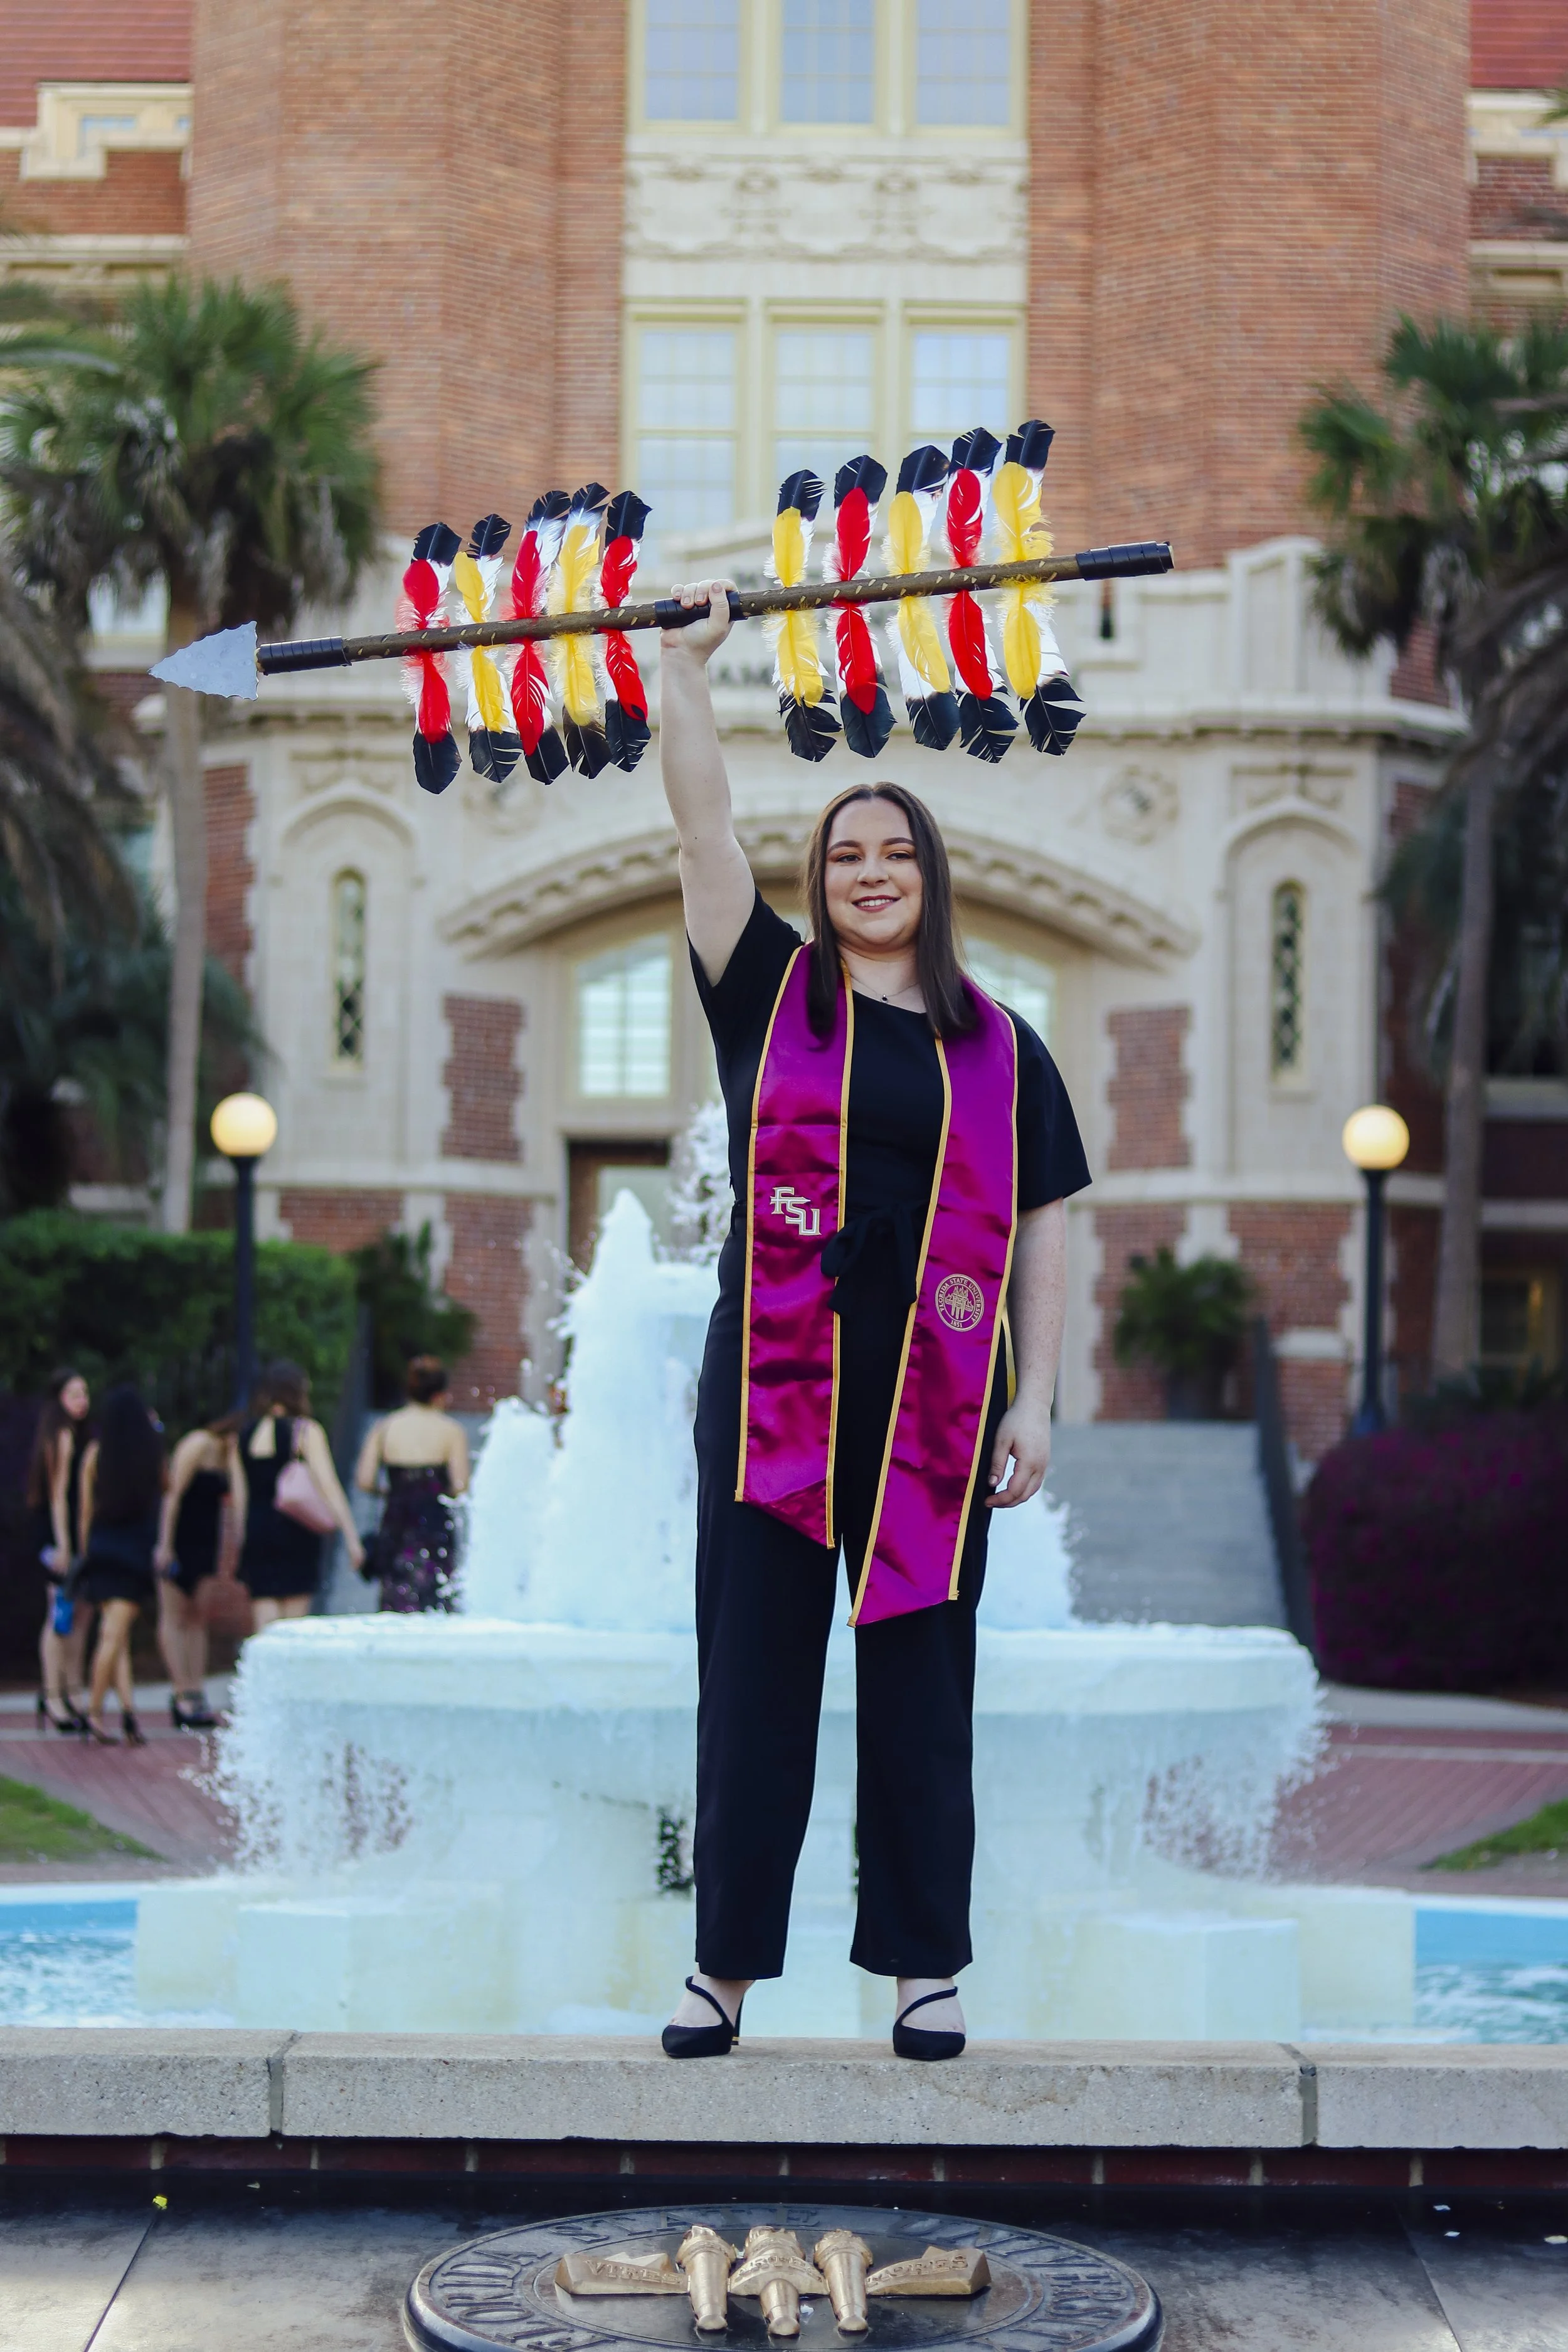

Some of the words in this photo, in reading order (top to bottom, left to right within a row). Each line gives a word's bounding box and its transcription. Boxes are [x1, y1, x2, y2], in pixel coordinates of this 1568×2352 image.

[770, 1187, 822, 1236] FSU
[938, 1283, 950, 1311] FLORIDA
[968, 1283, 981, 1323] UNIVERSITY
[950, 1320, 963, 1328] 1851
[585, 2260, 684, 2284] VIRES
